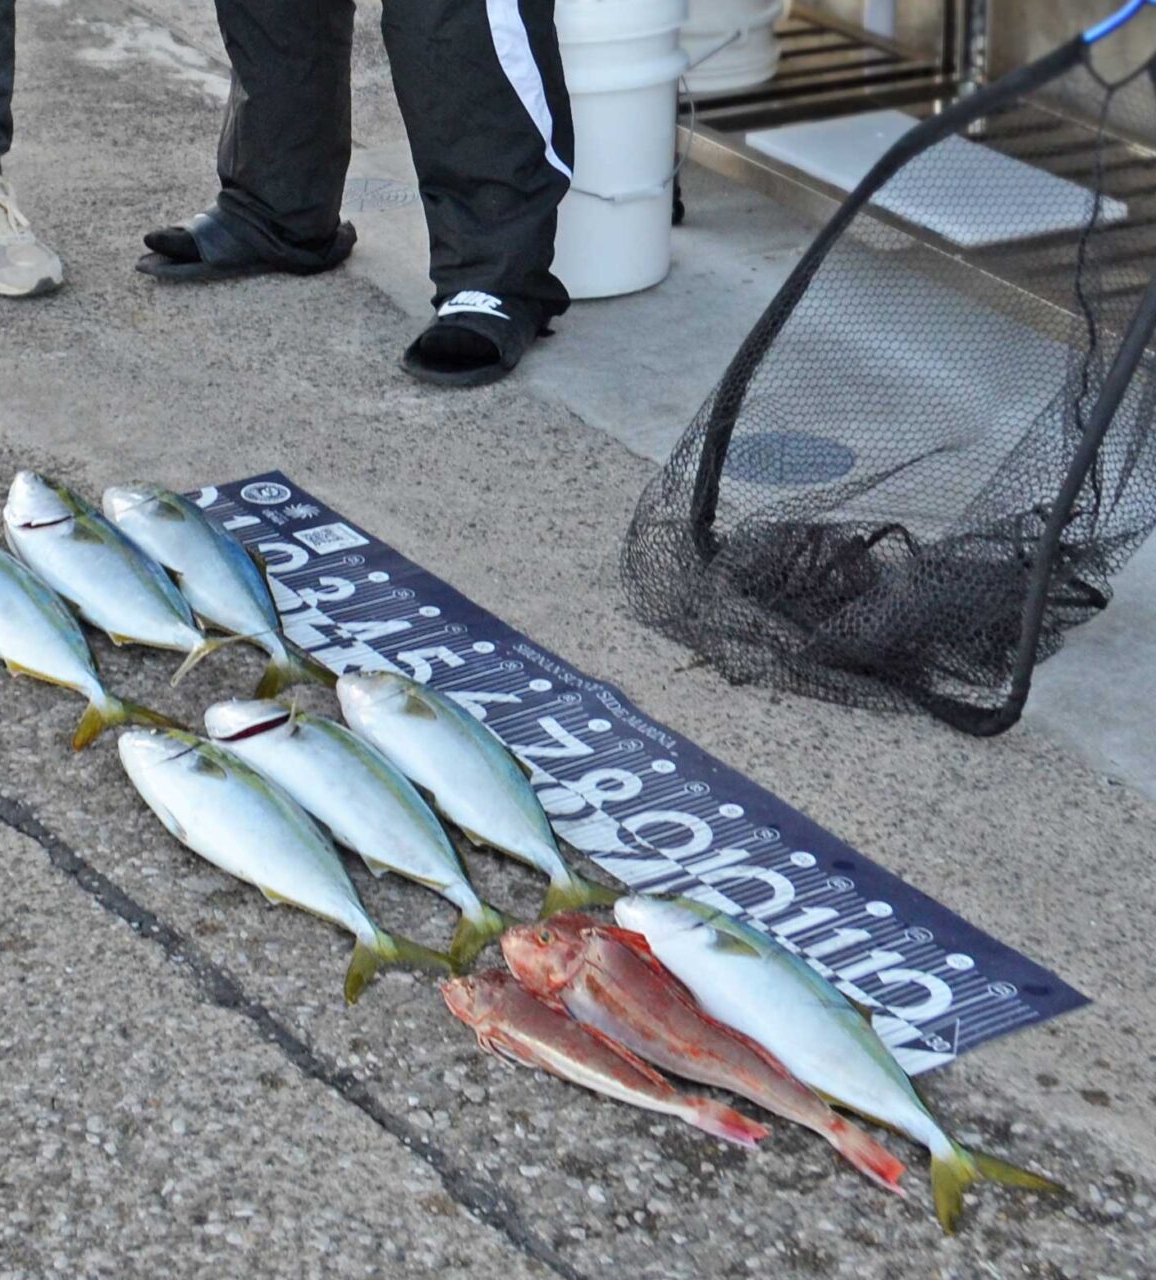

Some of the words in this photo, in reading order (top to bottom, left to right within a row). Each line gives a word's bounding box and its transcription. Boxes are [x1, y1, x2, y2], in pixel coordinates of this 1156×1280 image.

[448, 290, 502, 309] NIKE
[304, 620, 413, 652] 4
[511, 715, 594, 758] 7
[532, 768, 643, 820] 8
